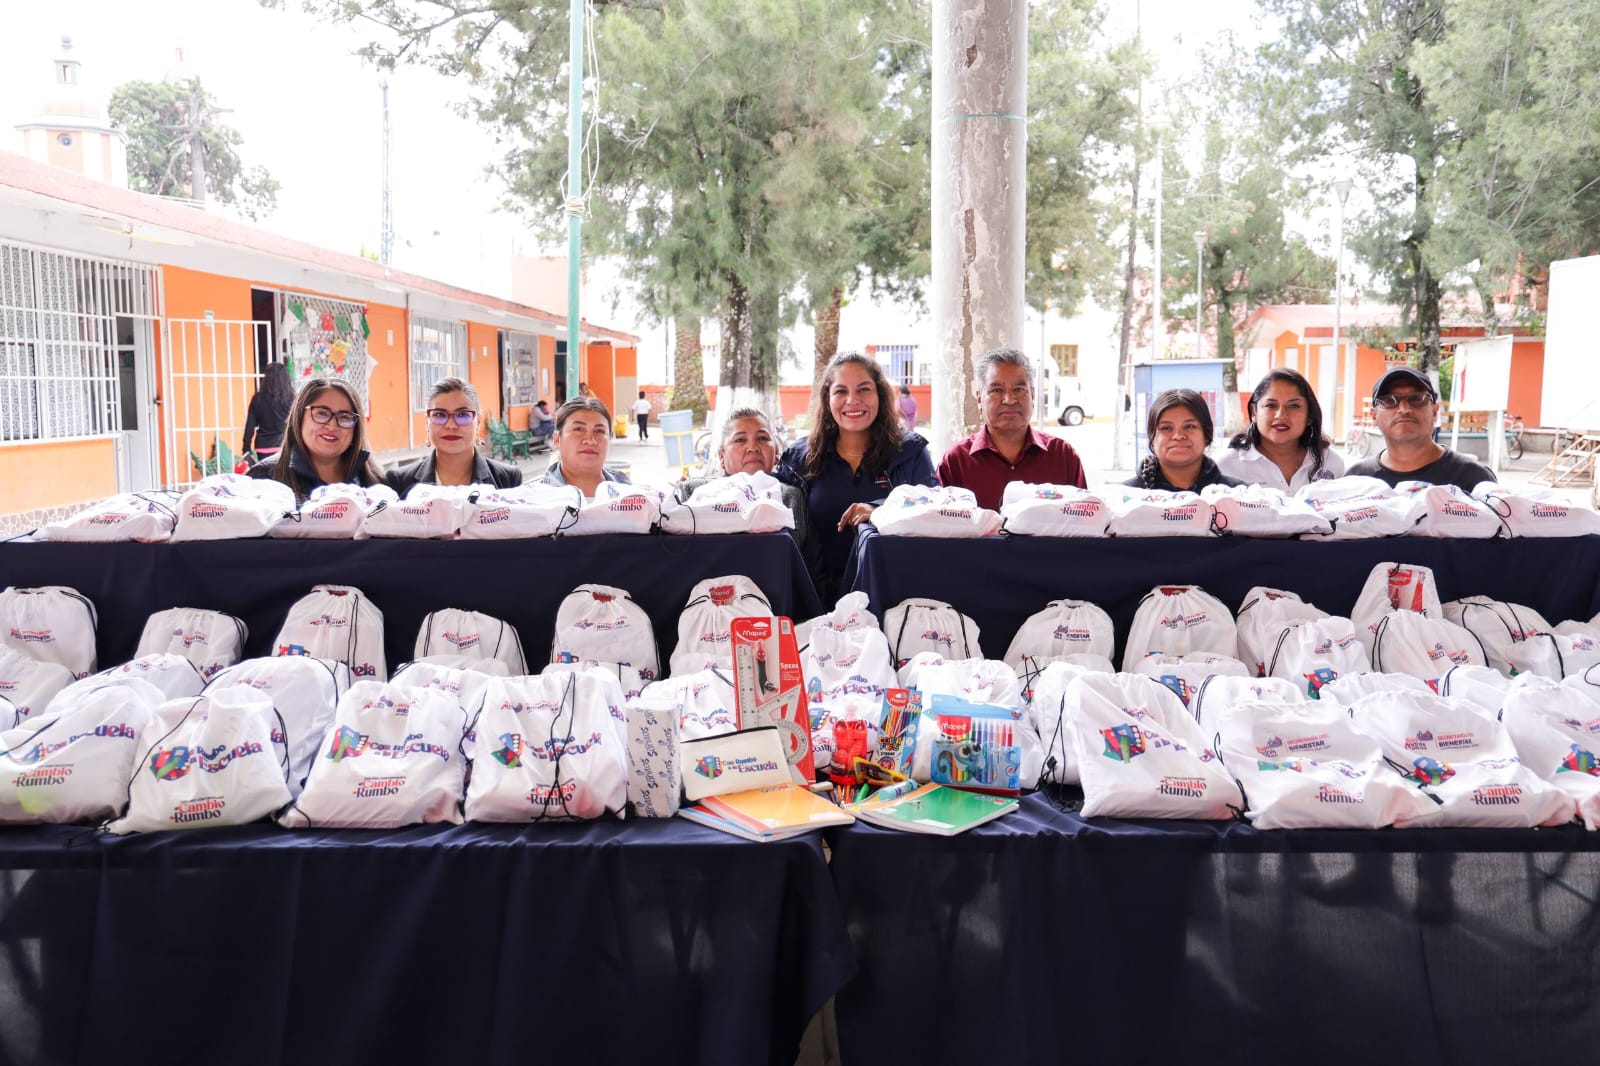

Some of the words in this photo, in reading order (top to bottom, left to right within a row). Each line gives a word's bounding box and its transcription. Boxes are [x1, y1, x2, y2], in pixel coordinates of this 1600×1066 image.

[192, 510, 224, 518] Rumbo
[610, 504, 642, 512] Rumbo
[714, 504, 741, 512] Rumb
[940, 509, 971, 519] Rumbo
[1063, 505, 1095, 517] Rumbo
[1445, 508, 1479, 517] Rumbo
[1532, 509, 1567, 517] Rumbo
[311, 510, 343, 519] Rumbo
[1163, 511, 1194, 520] Rumbo
[199, 741, 263, 773] Escuela
[738, 760, 778, 773] Escuela
[22, 767, 72, 779] Cambio
[640, 757, 658, 789] Sanitas
[16, 775, 65, 788] Rumbo
[361, 779, 405, 790] Cambio
[1164, 778, 1207, 790] Cambio
[356, 786, 399, 798] Rumbo
[1160, 783, 1203, 798] Rumbo
[1478, 785, 1522, 797] Cambio
[1473, 793, 1521, 806] Rumbo
[177, 799, 225, 814] Cambio
[174, 808, 222, 823] Rumbo
